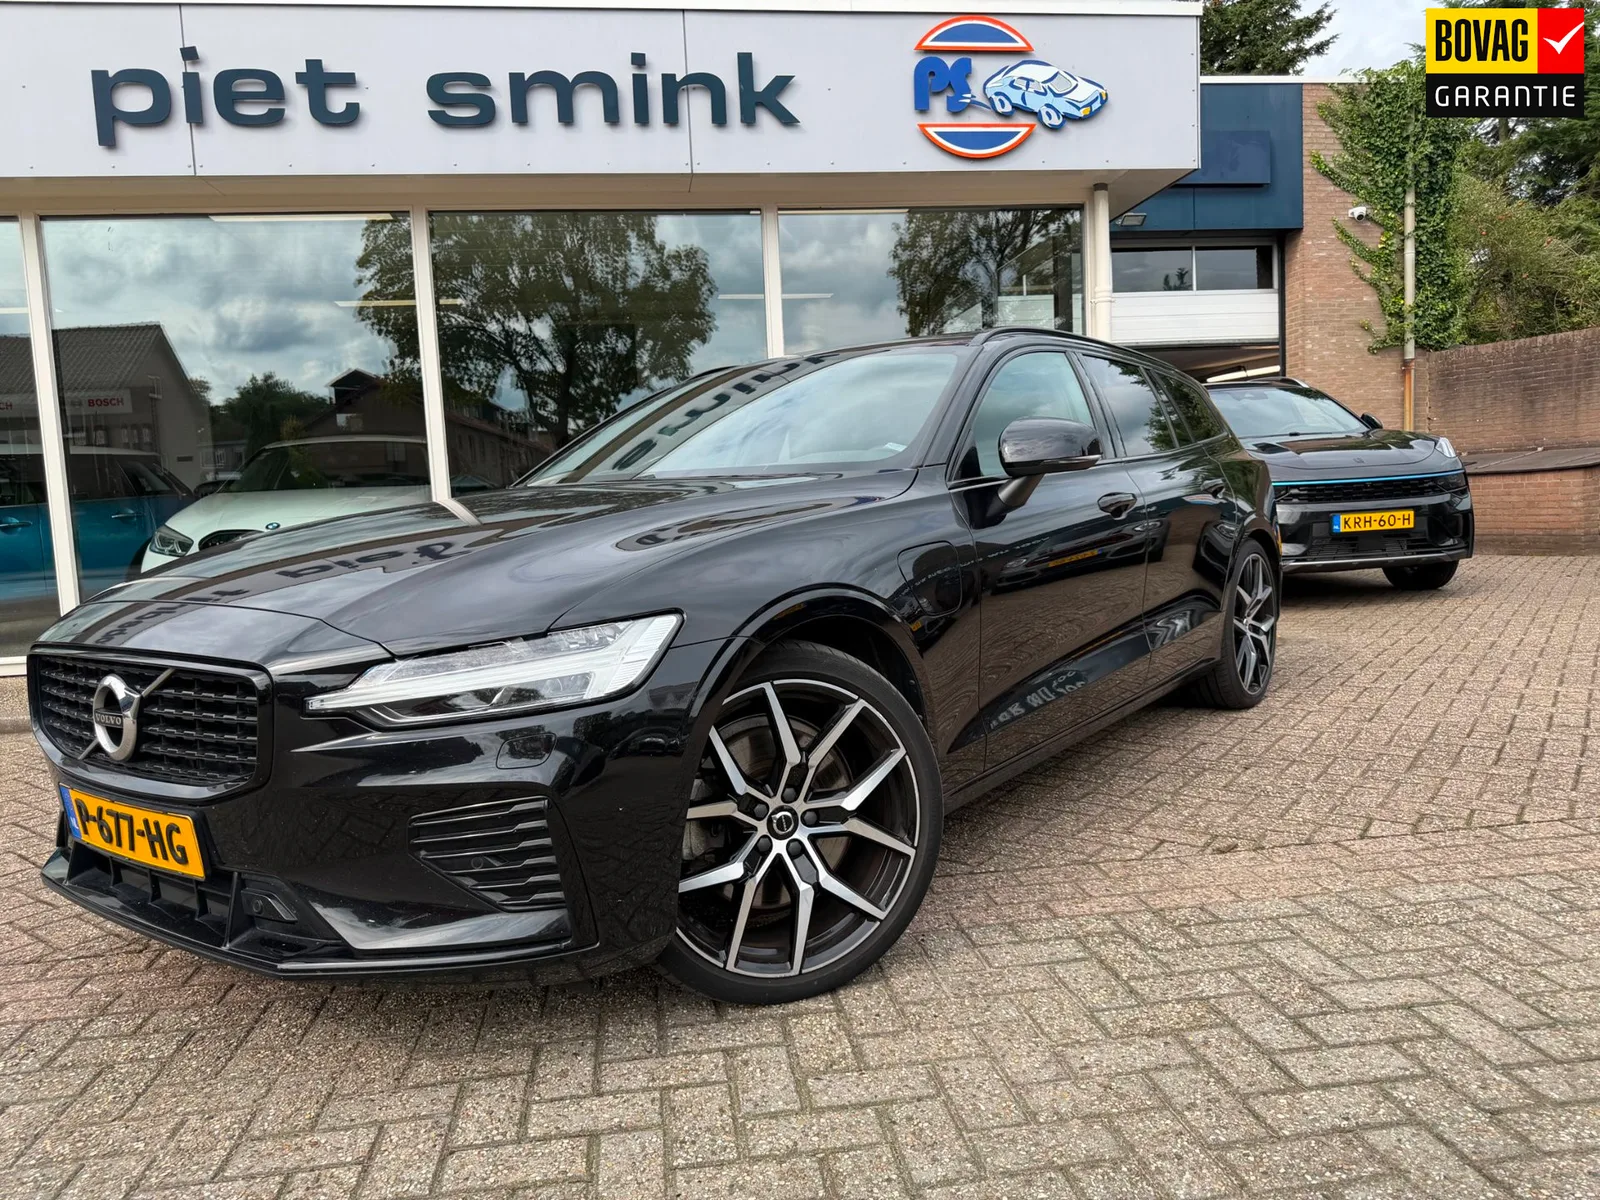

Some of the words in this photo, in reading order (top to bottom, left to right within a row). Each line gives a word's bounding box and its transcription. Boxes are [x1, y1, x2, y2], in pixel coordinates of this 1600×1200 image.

[91, 46, 361, 147] piet
[427, 52, 801, 128] smink
[87, 397, 125, 408] BOSCH
[1343, 513, 1411, 529] KRH-60-H
[95, 713, 122, 726] VOLVO
[74, 797, 189, 866] P-677-HG
